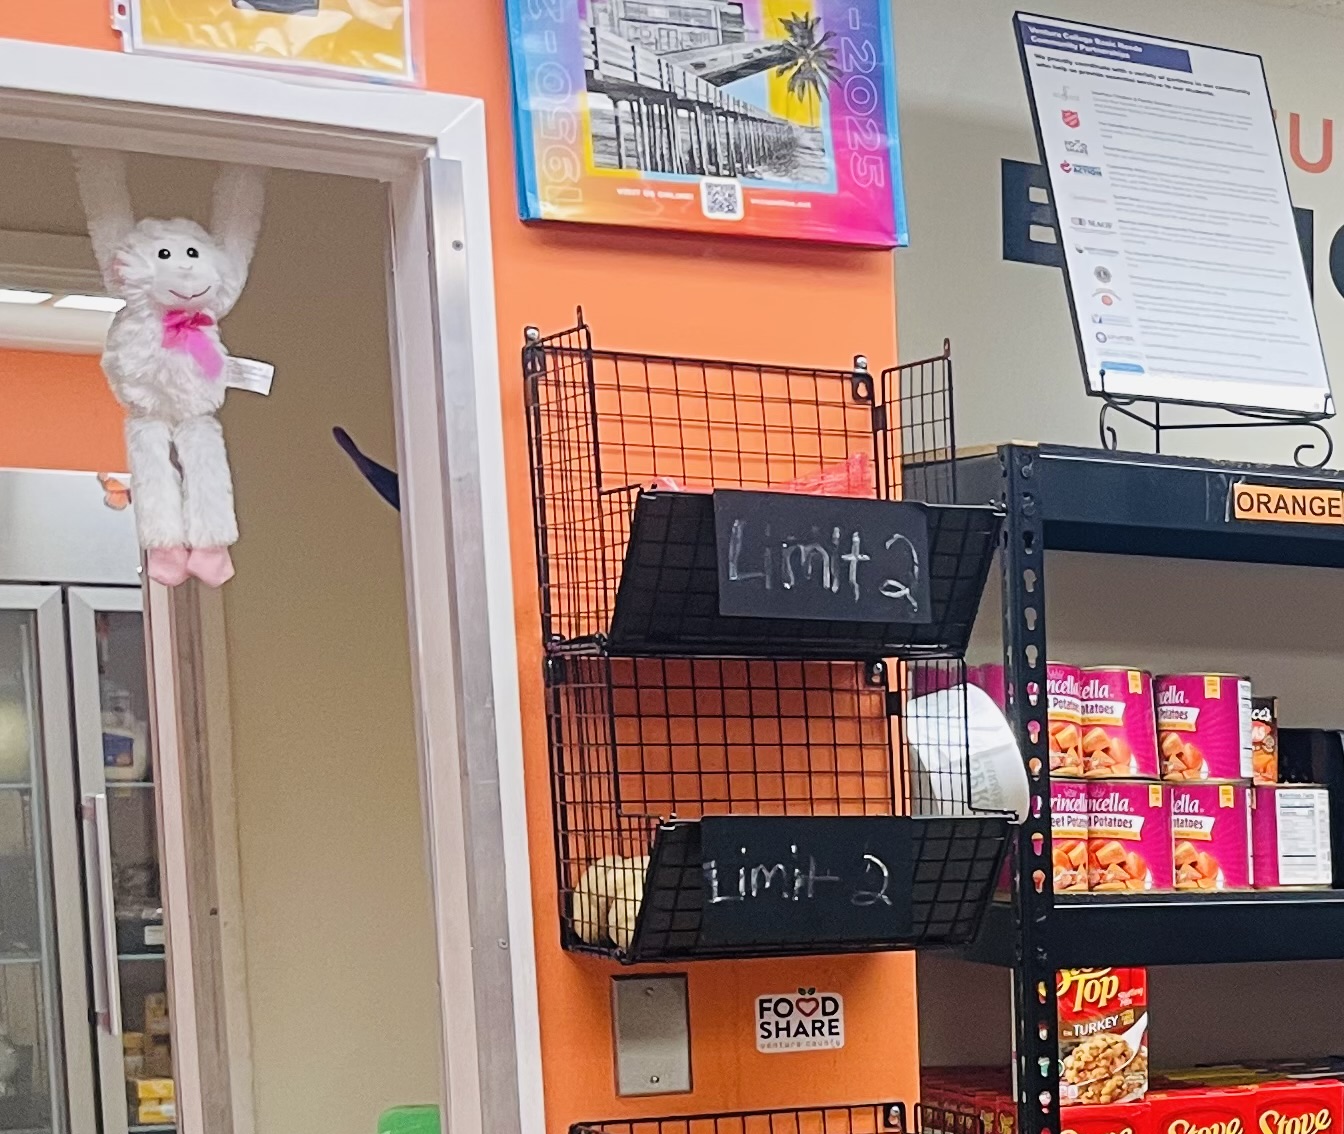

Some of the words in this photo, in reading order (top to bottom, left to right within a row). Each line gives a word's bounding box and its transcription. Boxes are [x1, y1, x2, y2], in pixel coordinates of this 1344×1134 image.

[1063, 32, 1094, 45] College
[841, 37, 884, 189] 2025
[1237, 491, 1342, 519] ORANGE
[728, 518, 871, 604] Limit
[879, 532, 920, 613] 2
[701, 843, 841, 904] Limit
[851, 853, 893, 906] 2
[1072, 973, 1119, 1013] Top
[760, 1019, 840, 1039] SHARE
[1073, 1014, 1119, 1037] TURKEY
